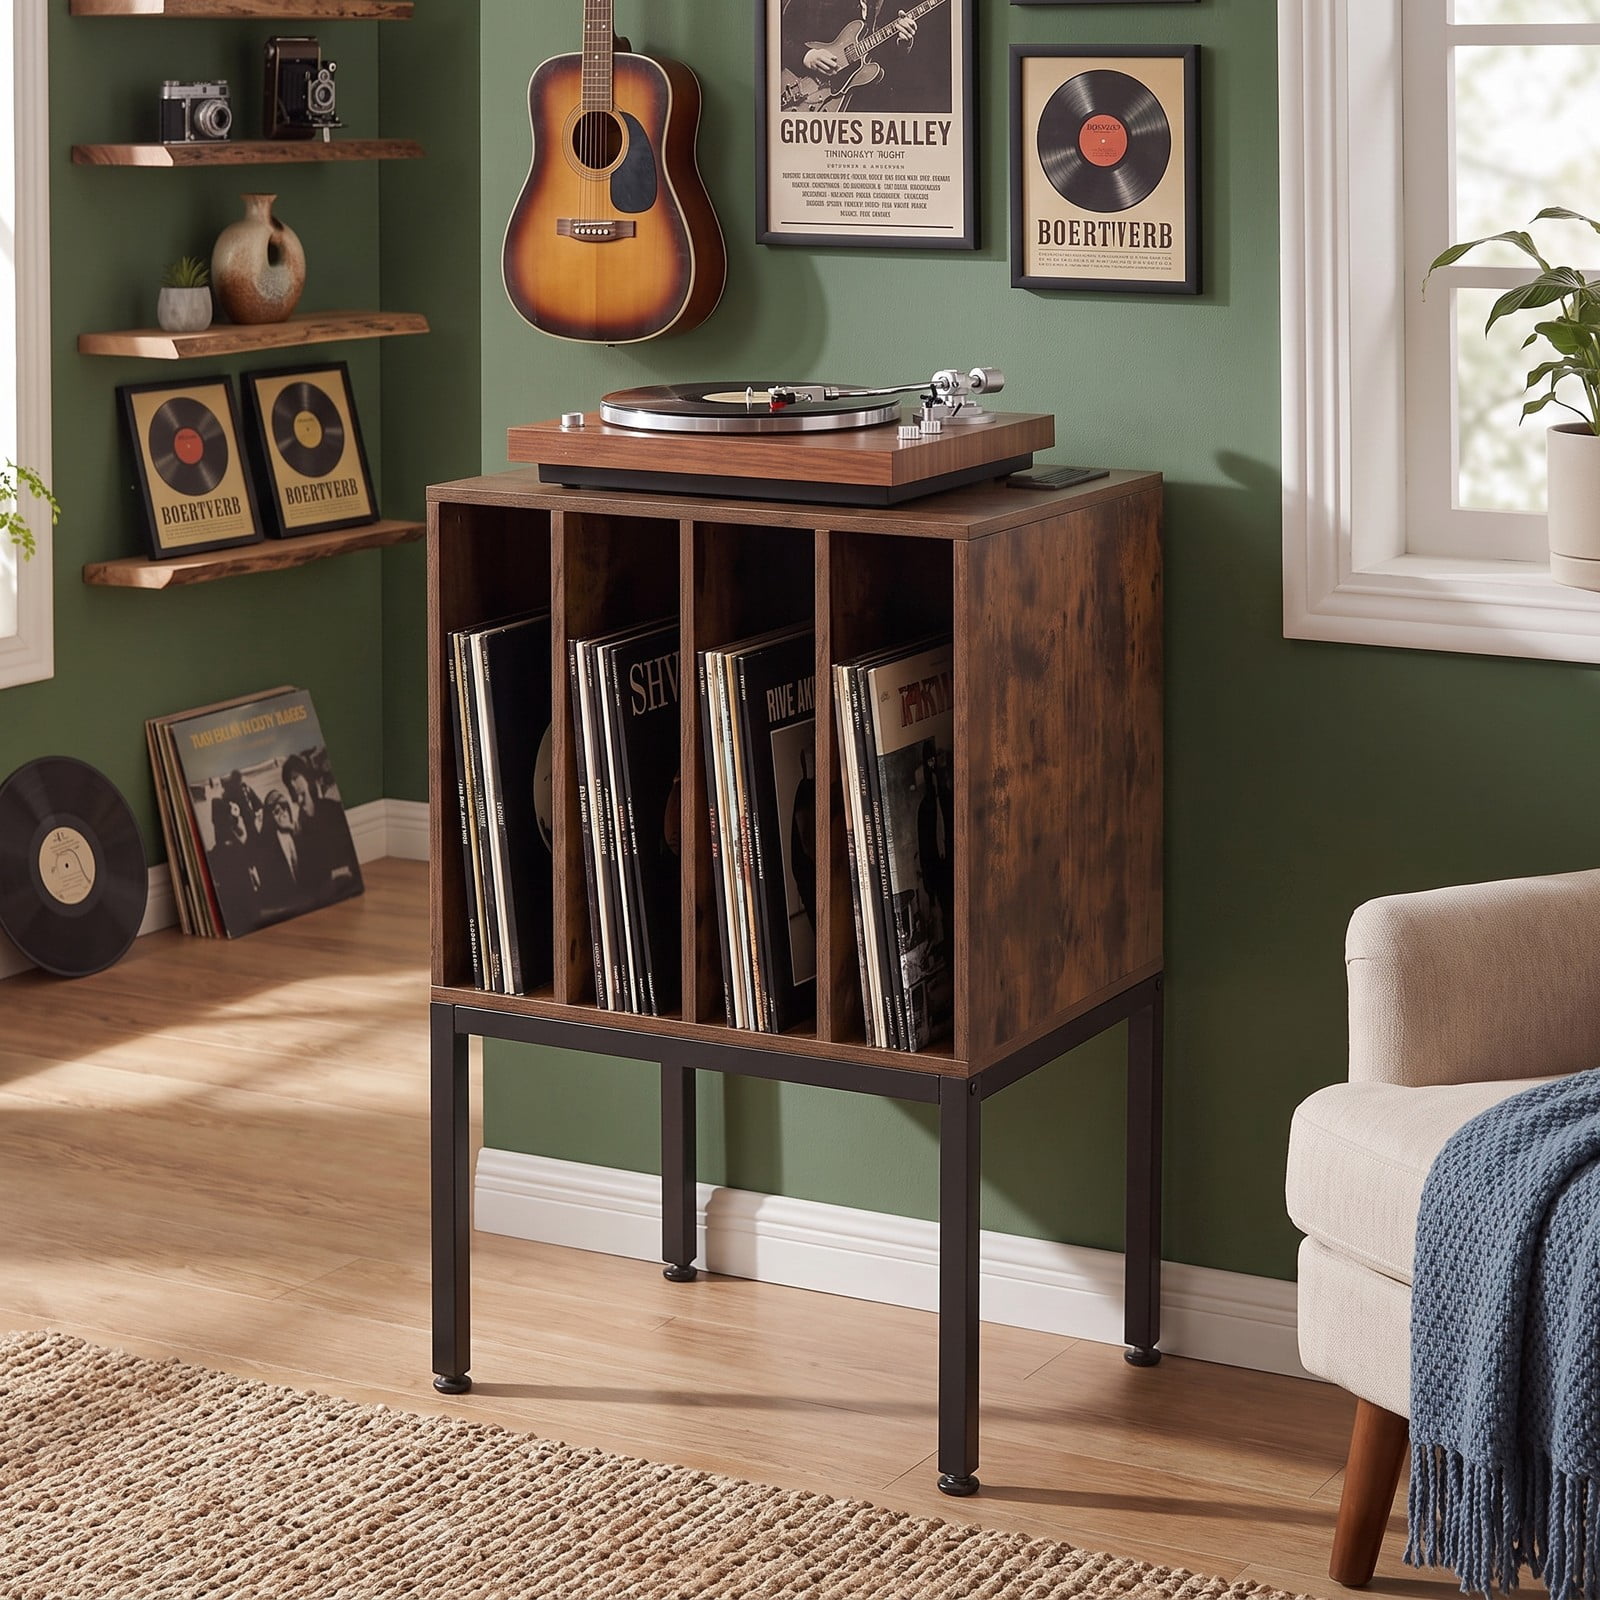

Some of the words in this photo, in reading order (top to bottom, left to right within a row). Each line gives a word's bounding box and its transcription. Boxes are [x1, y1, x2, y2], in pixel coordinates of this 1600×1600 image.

[780, 118, 863, 145] GROVES
[871, 119, 952, 146] BALLEY
[285, 477, 359, 505] BOERTVERB
[161, 495, 242, 525] BOERTVERB
[766, 682, 796, 723] RIVE
